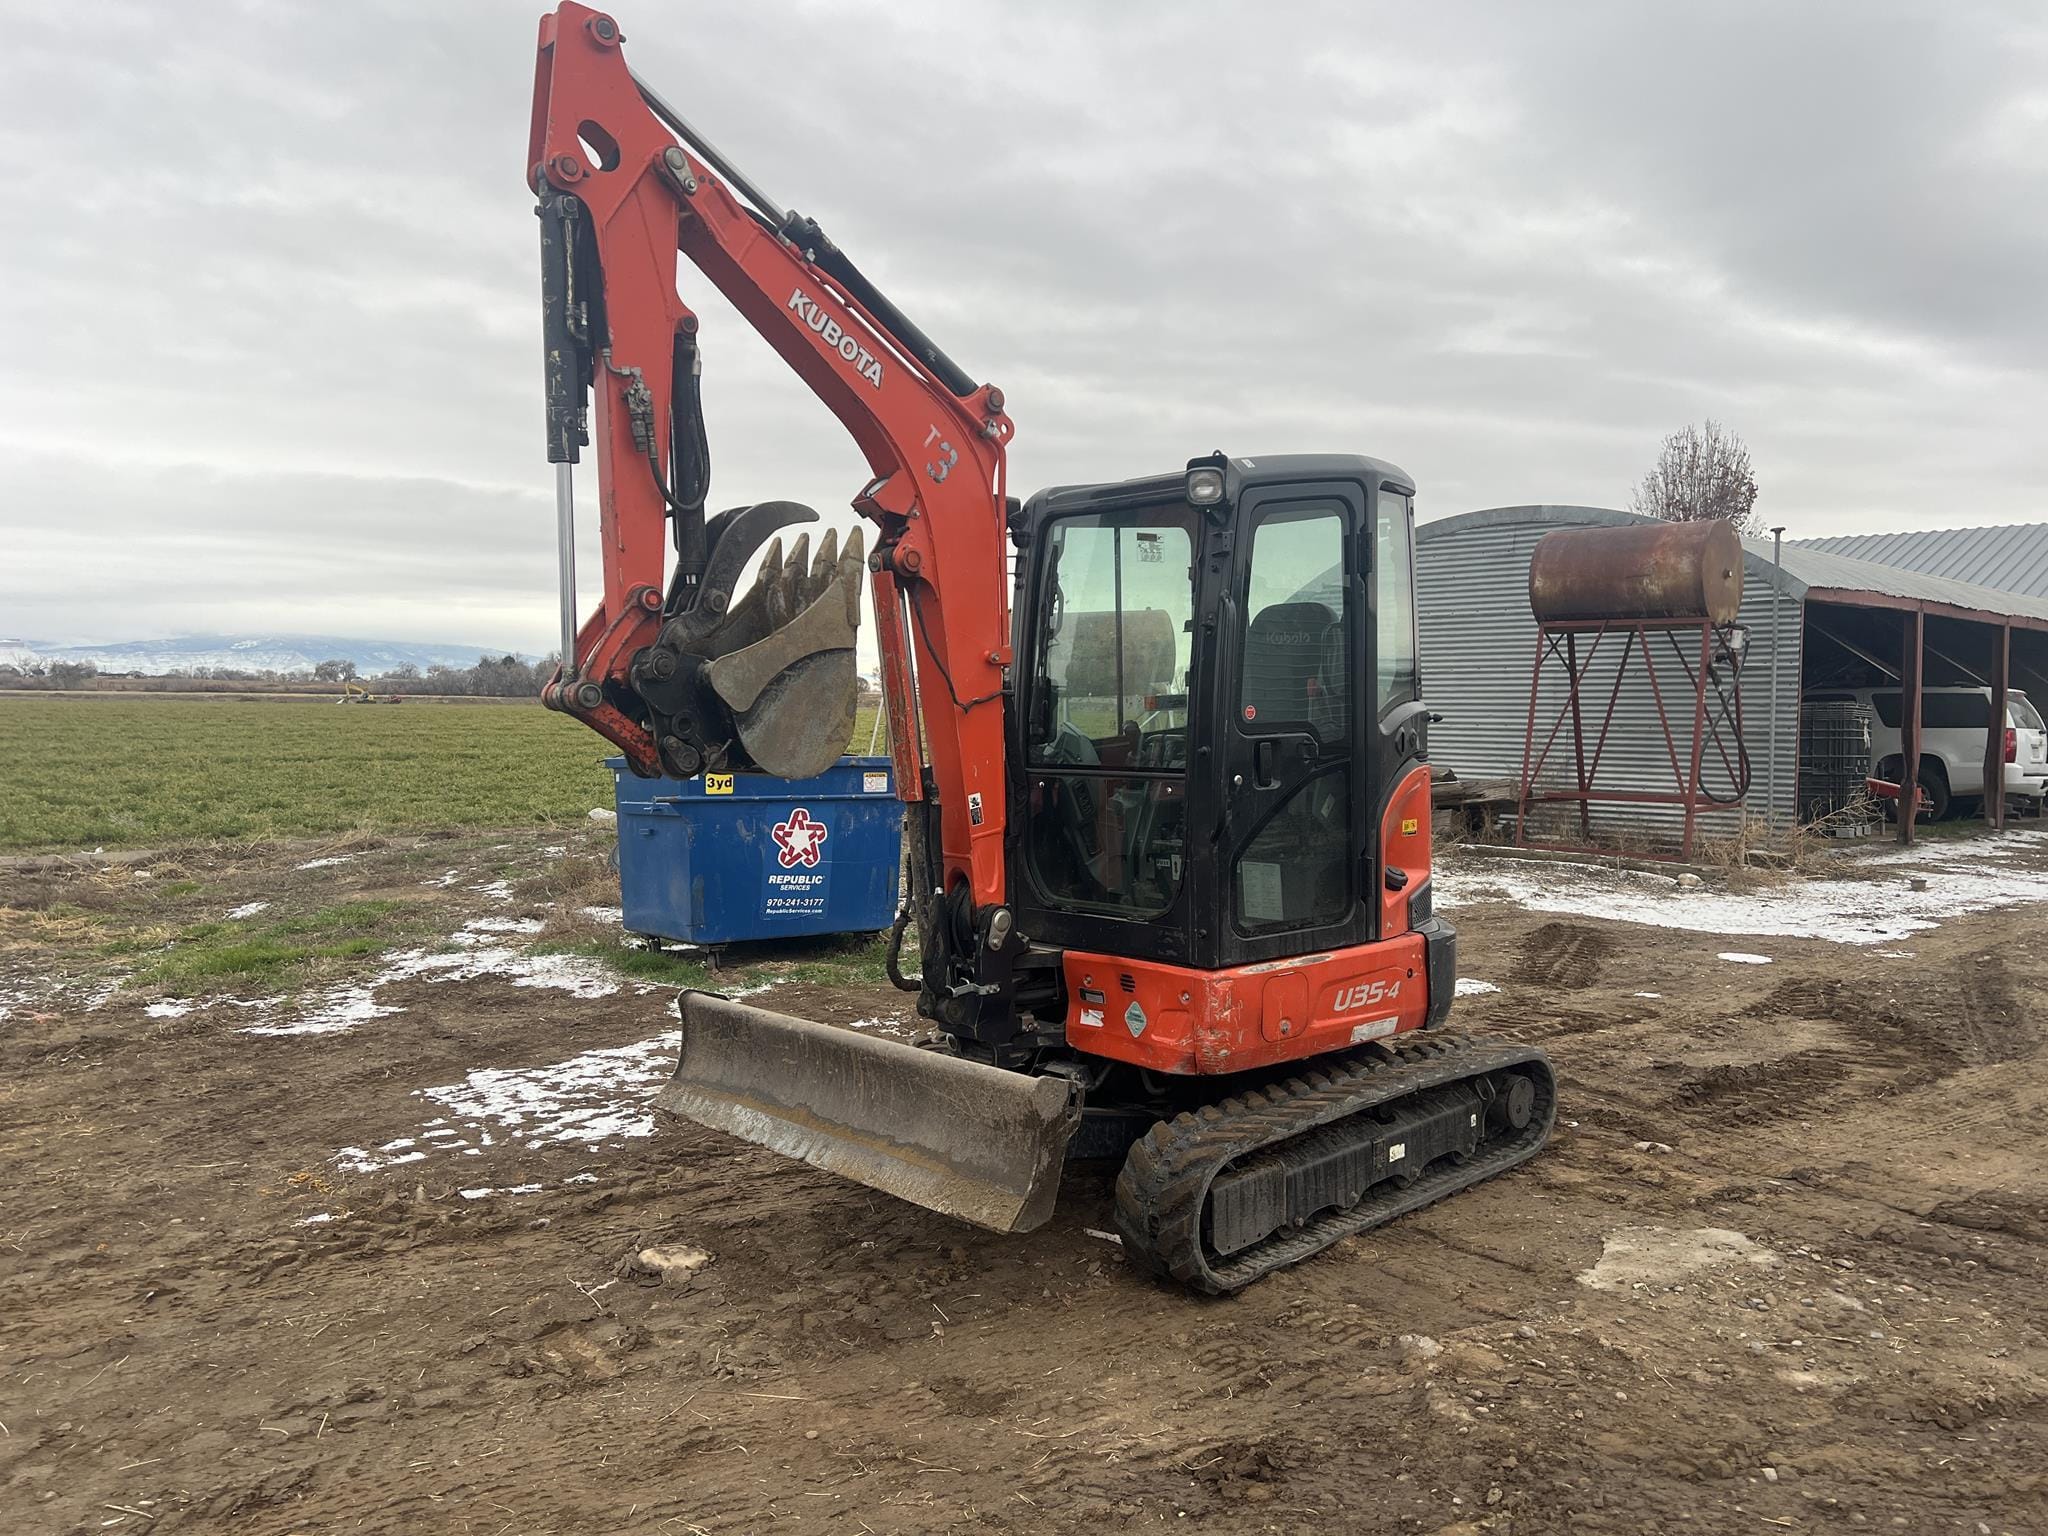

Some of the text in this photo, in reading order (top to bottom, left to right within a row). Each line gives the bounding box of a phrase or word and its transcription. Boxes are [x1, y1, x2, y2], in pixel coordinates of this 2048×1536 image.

[787, 287, 885, 389] KUBOTA
[706, 776, 732, 790] 3yd
[768, 875, 823, 885] REPUBLIC
[766, 898, 824, 907] 970-241-3177
[1333, 980, 1401, 1011] U35-4
